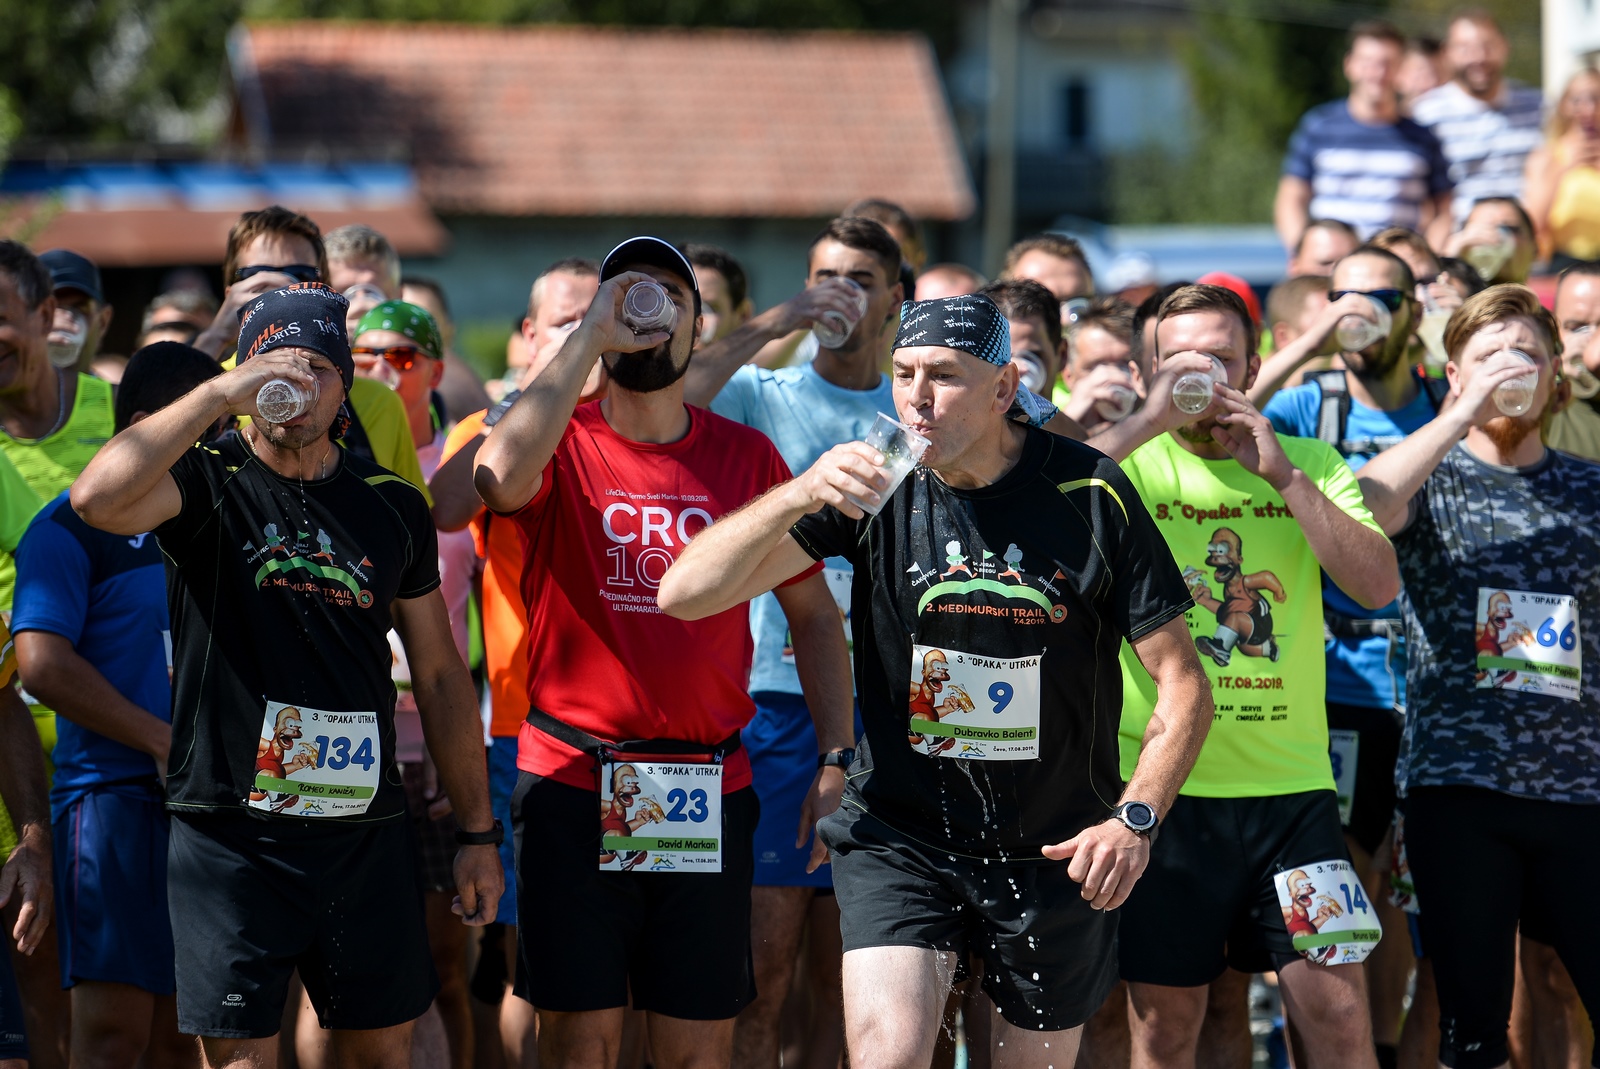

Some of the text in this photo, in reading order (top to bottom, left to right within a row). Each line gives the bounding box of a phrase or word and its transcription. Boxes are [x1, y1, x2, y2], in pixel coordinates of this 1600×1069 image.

[1253, 501, 1294, 519] utrk
[602, 502, 714, 547] CRO
[261, 578, 271, 587] 2.
[322, 588, 353, 600] TRAIL
[926, 603, 1045, 618] 2. MEĐIMURSKI TRAIL
[1536, 617, 1577, 651] 66
[957, 655, 965, 664] 3.
[1009, 659, 1038, 670] UTRKA
[988, 681, 1014, 714] 9
[311, 712, 321, 722] 3.
[357, 715, 376, 724] UTRKA
[954, 727, 1033, 739] Dubravko Balent
[315, 735, 375, 771] 134
[647, 767, 656, 775] 3.
[695, 768, 719, 776] UTRKA
[298, 783, 325, 794] ROMEO
[666, 788, 709, 823] 23
[657, 840, 716, 849] David Markan
[1340, 883, 1367, 915] 14
